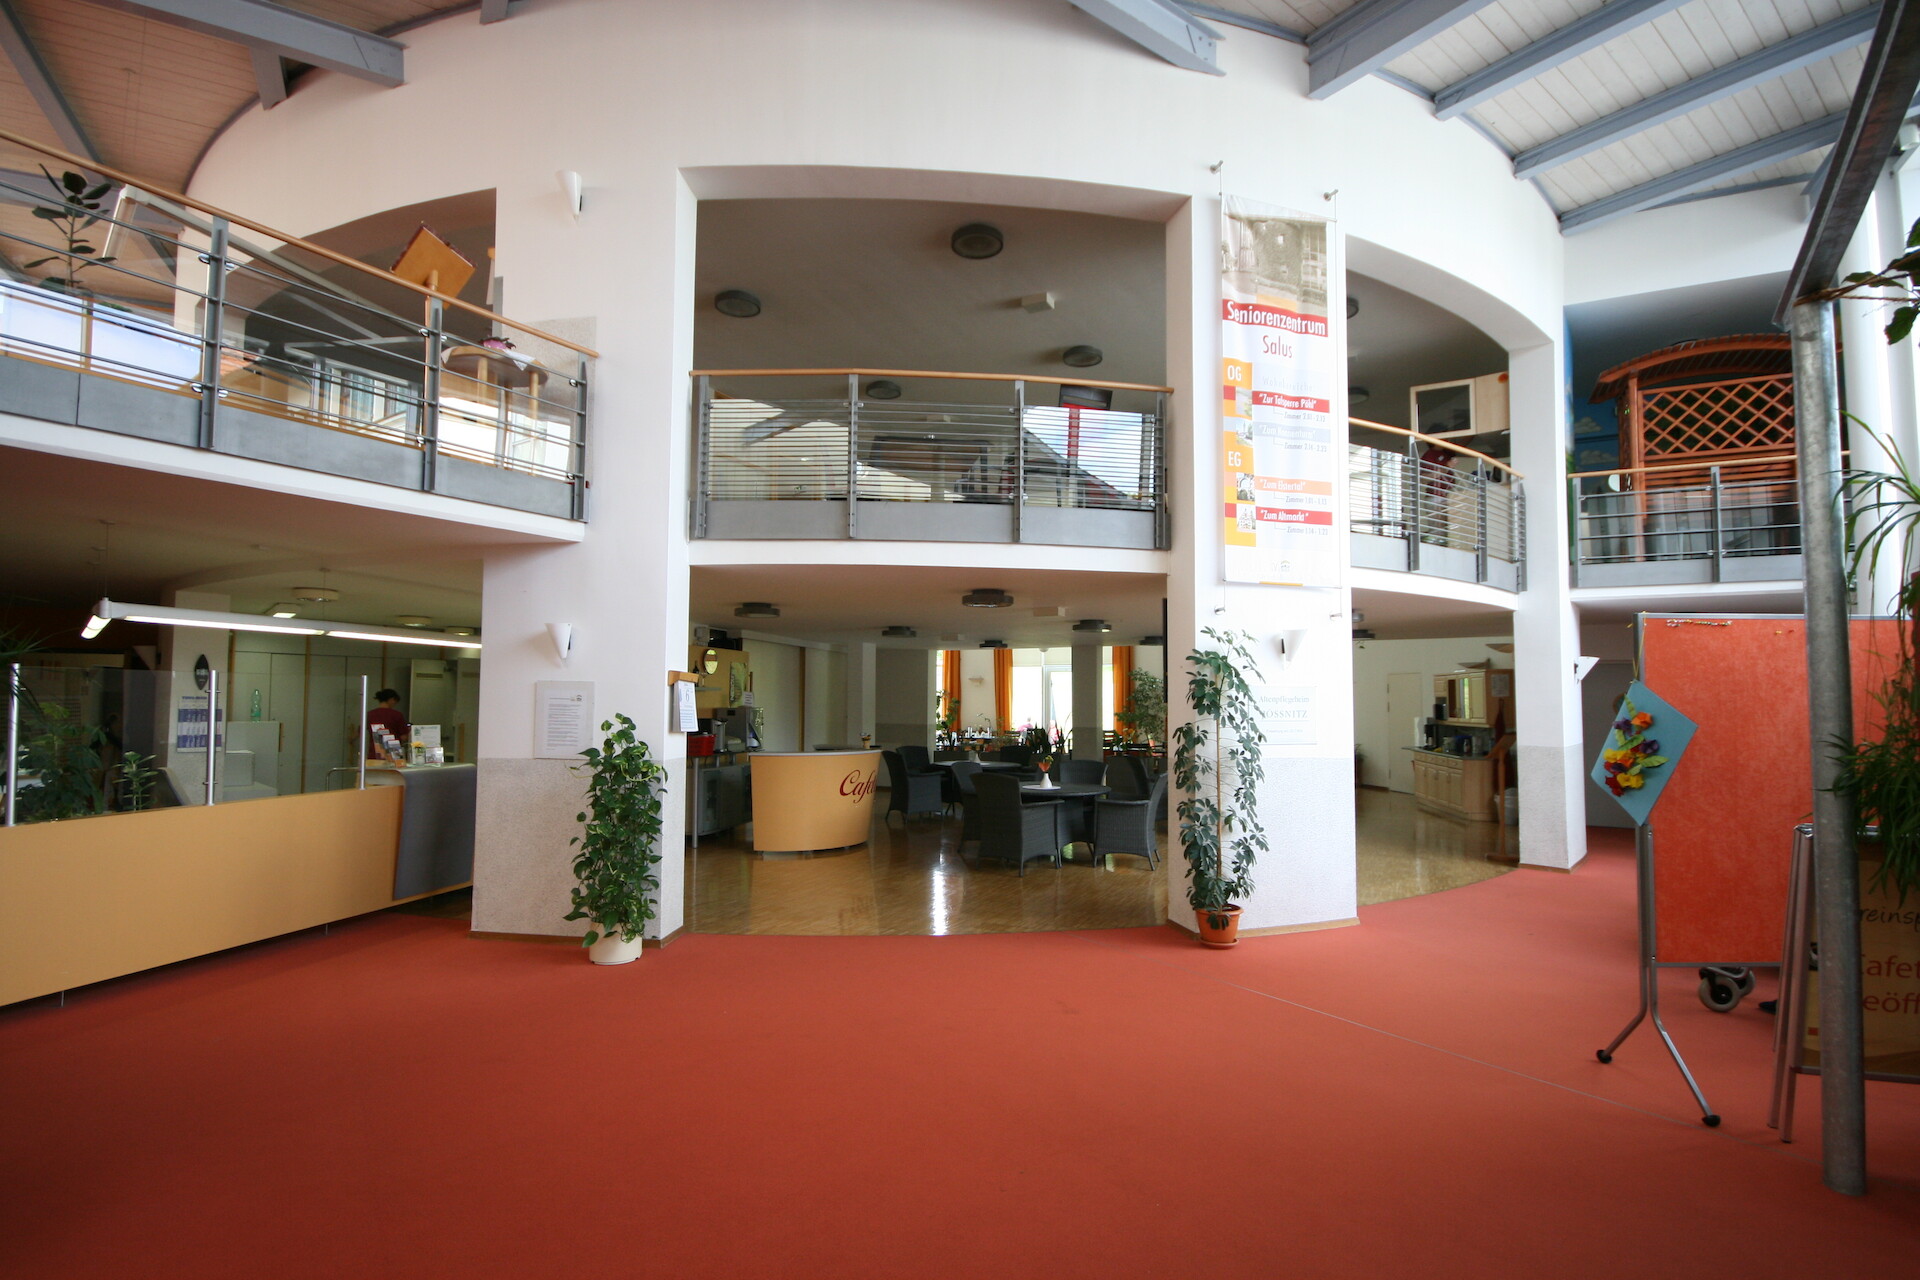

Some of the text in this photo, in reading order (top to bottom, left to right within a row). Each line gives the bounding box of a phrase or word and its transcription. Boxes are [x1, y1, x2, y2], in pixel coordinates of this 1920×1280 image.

[1227, 301, 1326, 336] Seniorenzentrum
[1262, 335, 1293, 358] Salus
[1227, 365, 1242, 381] OG
[1228, 451, 1242, 467] EG
